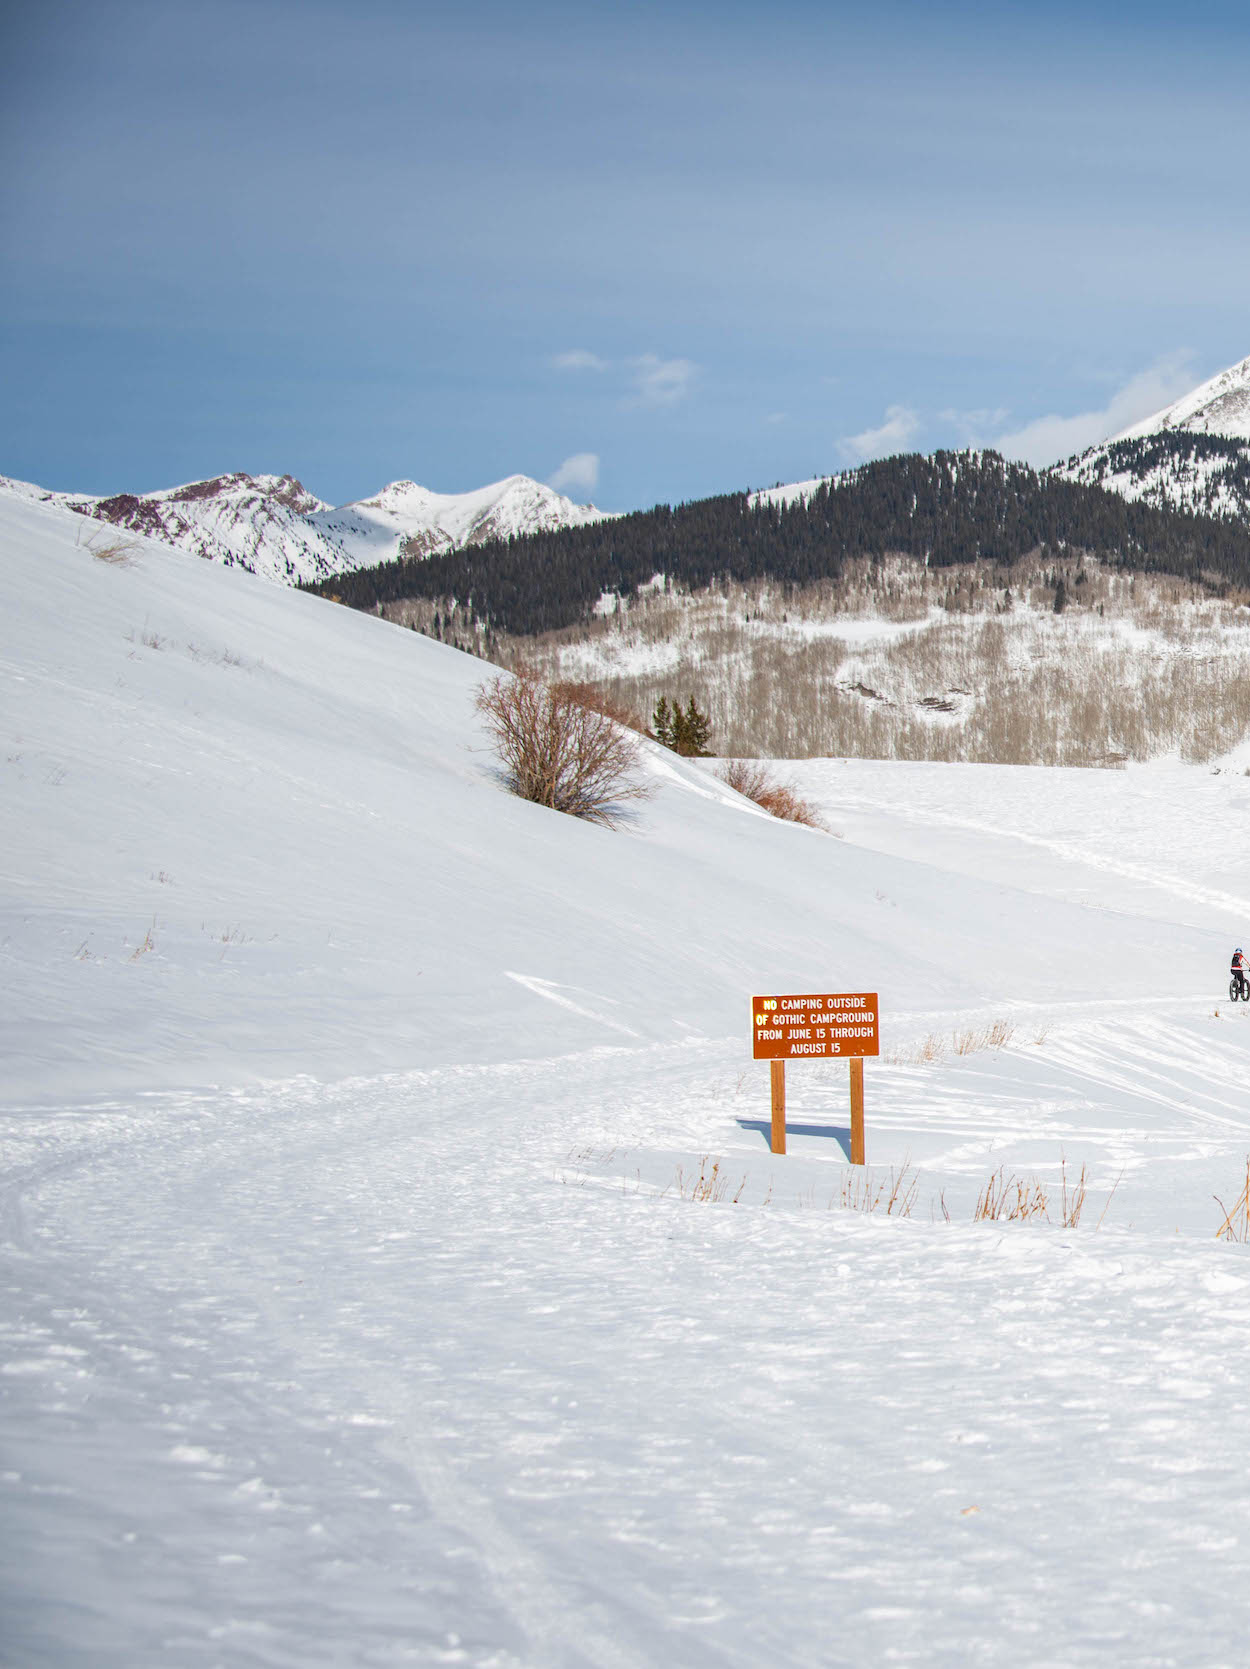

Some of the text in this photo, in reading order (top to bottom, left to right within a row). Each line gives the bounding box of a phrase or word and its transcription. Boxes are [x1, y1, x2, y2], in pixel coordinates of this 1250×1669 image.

[764, 997, 866, 1010] NO CAMPING OUTSIDE
[756, 1012, 875, 1026] OF GOTHIC CAMPGROUND
[757, 1027, 874, 1040] FROM JUNE 15 THROUGH
[790, 1043, 841, 1054] AUGUST 15
